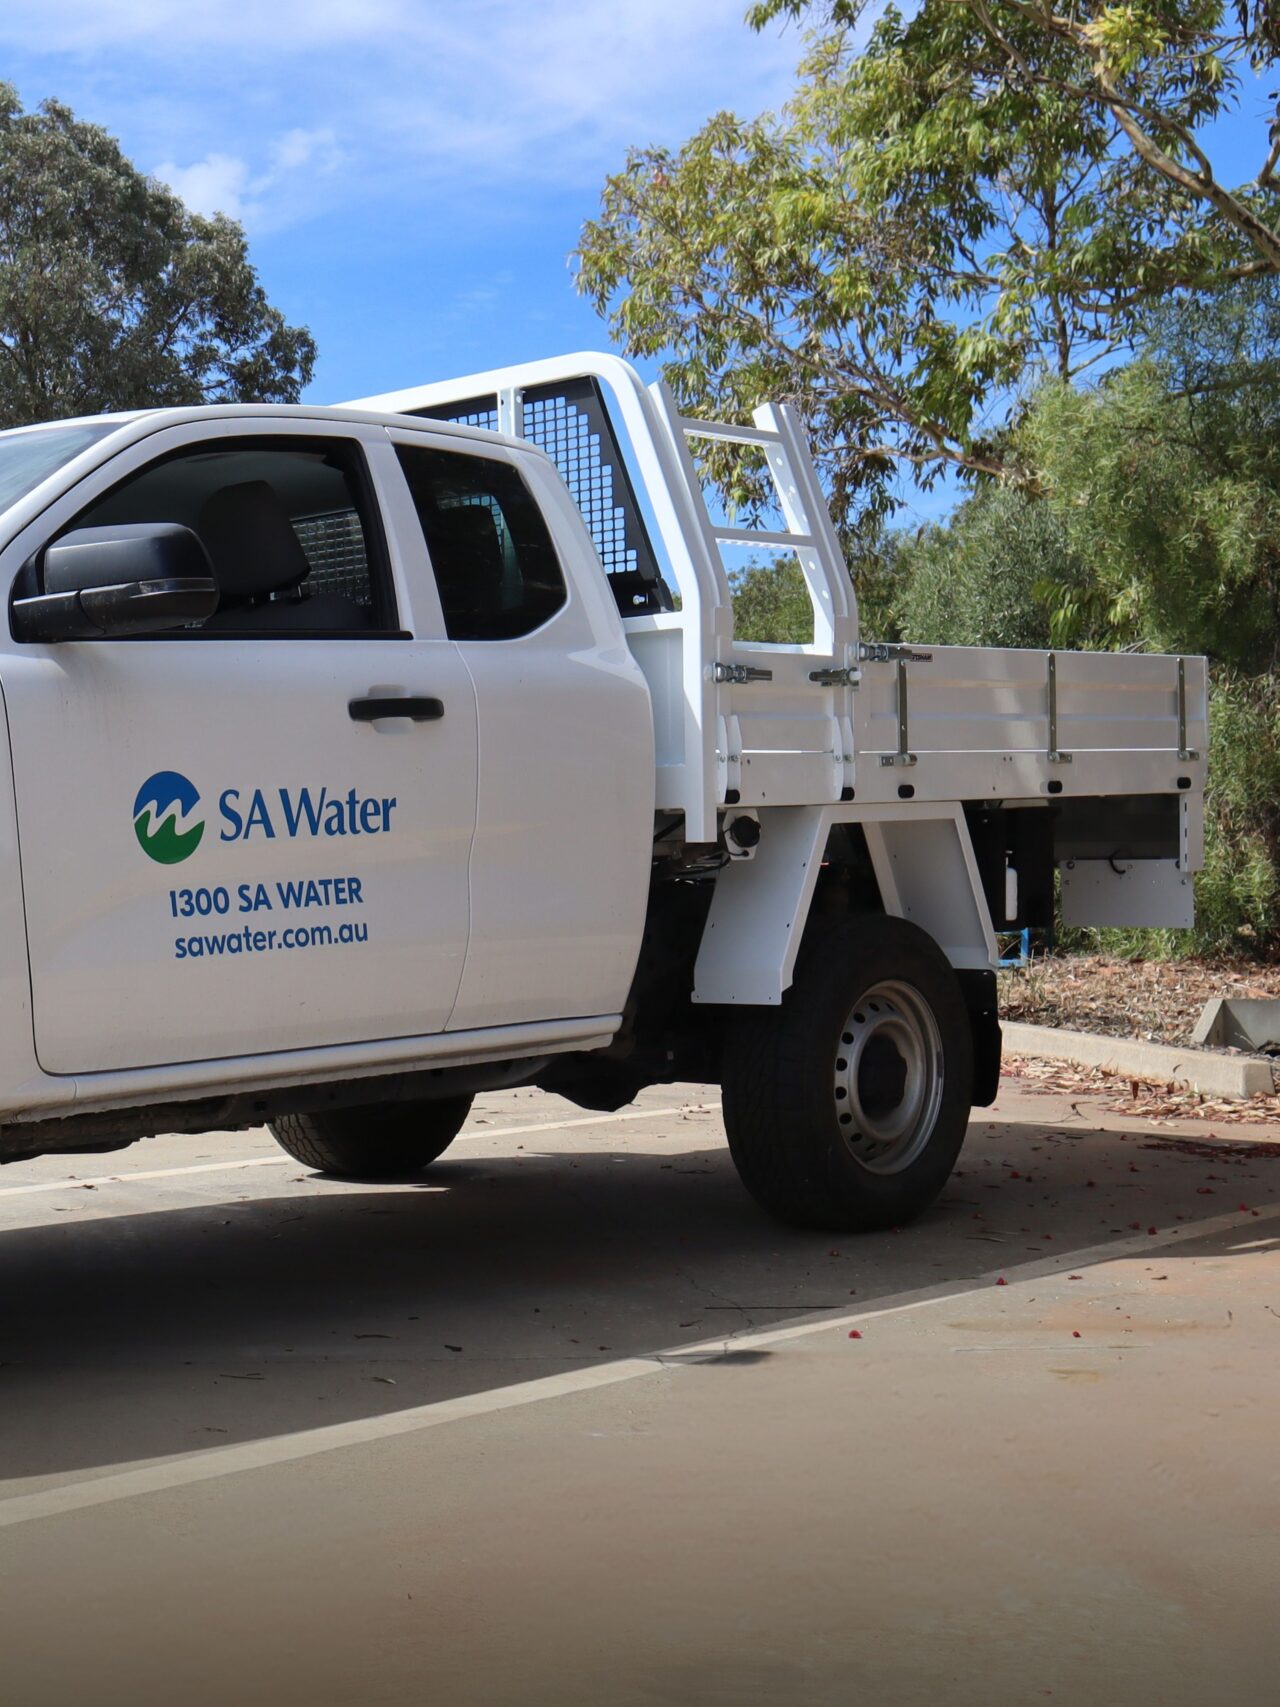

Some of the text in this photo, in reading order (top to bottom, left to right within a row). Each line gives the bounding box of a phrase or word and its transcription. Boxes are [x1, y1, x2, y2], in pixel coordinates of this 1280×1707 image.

[219, 787, 397, 842] SA Water
[169, 877, 364, 918] 1300 SA WATER
[175, 922, 368, 959] sawater.com.au
